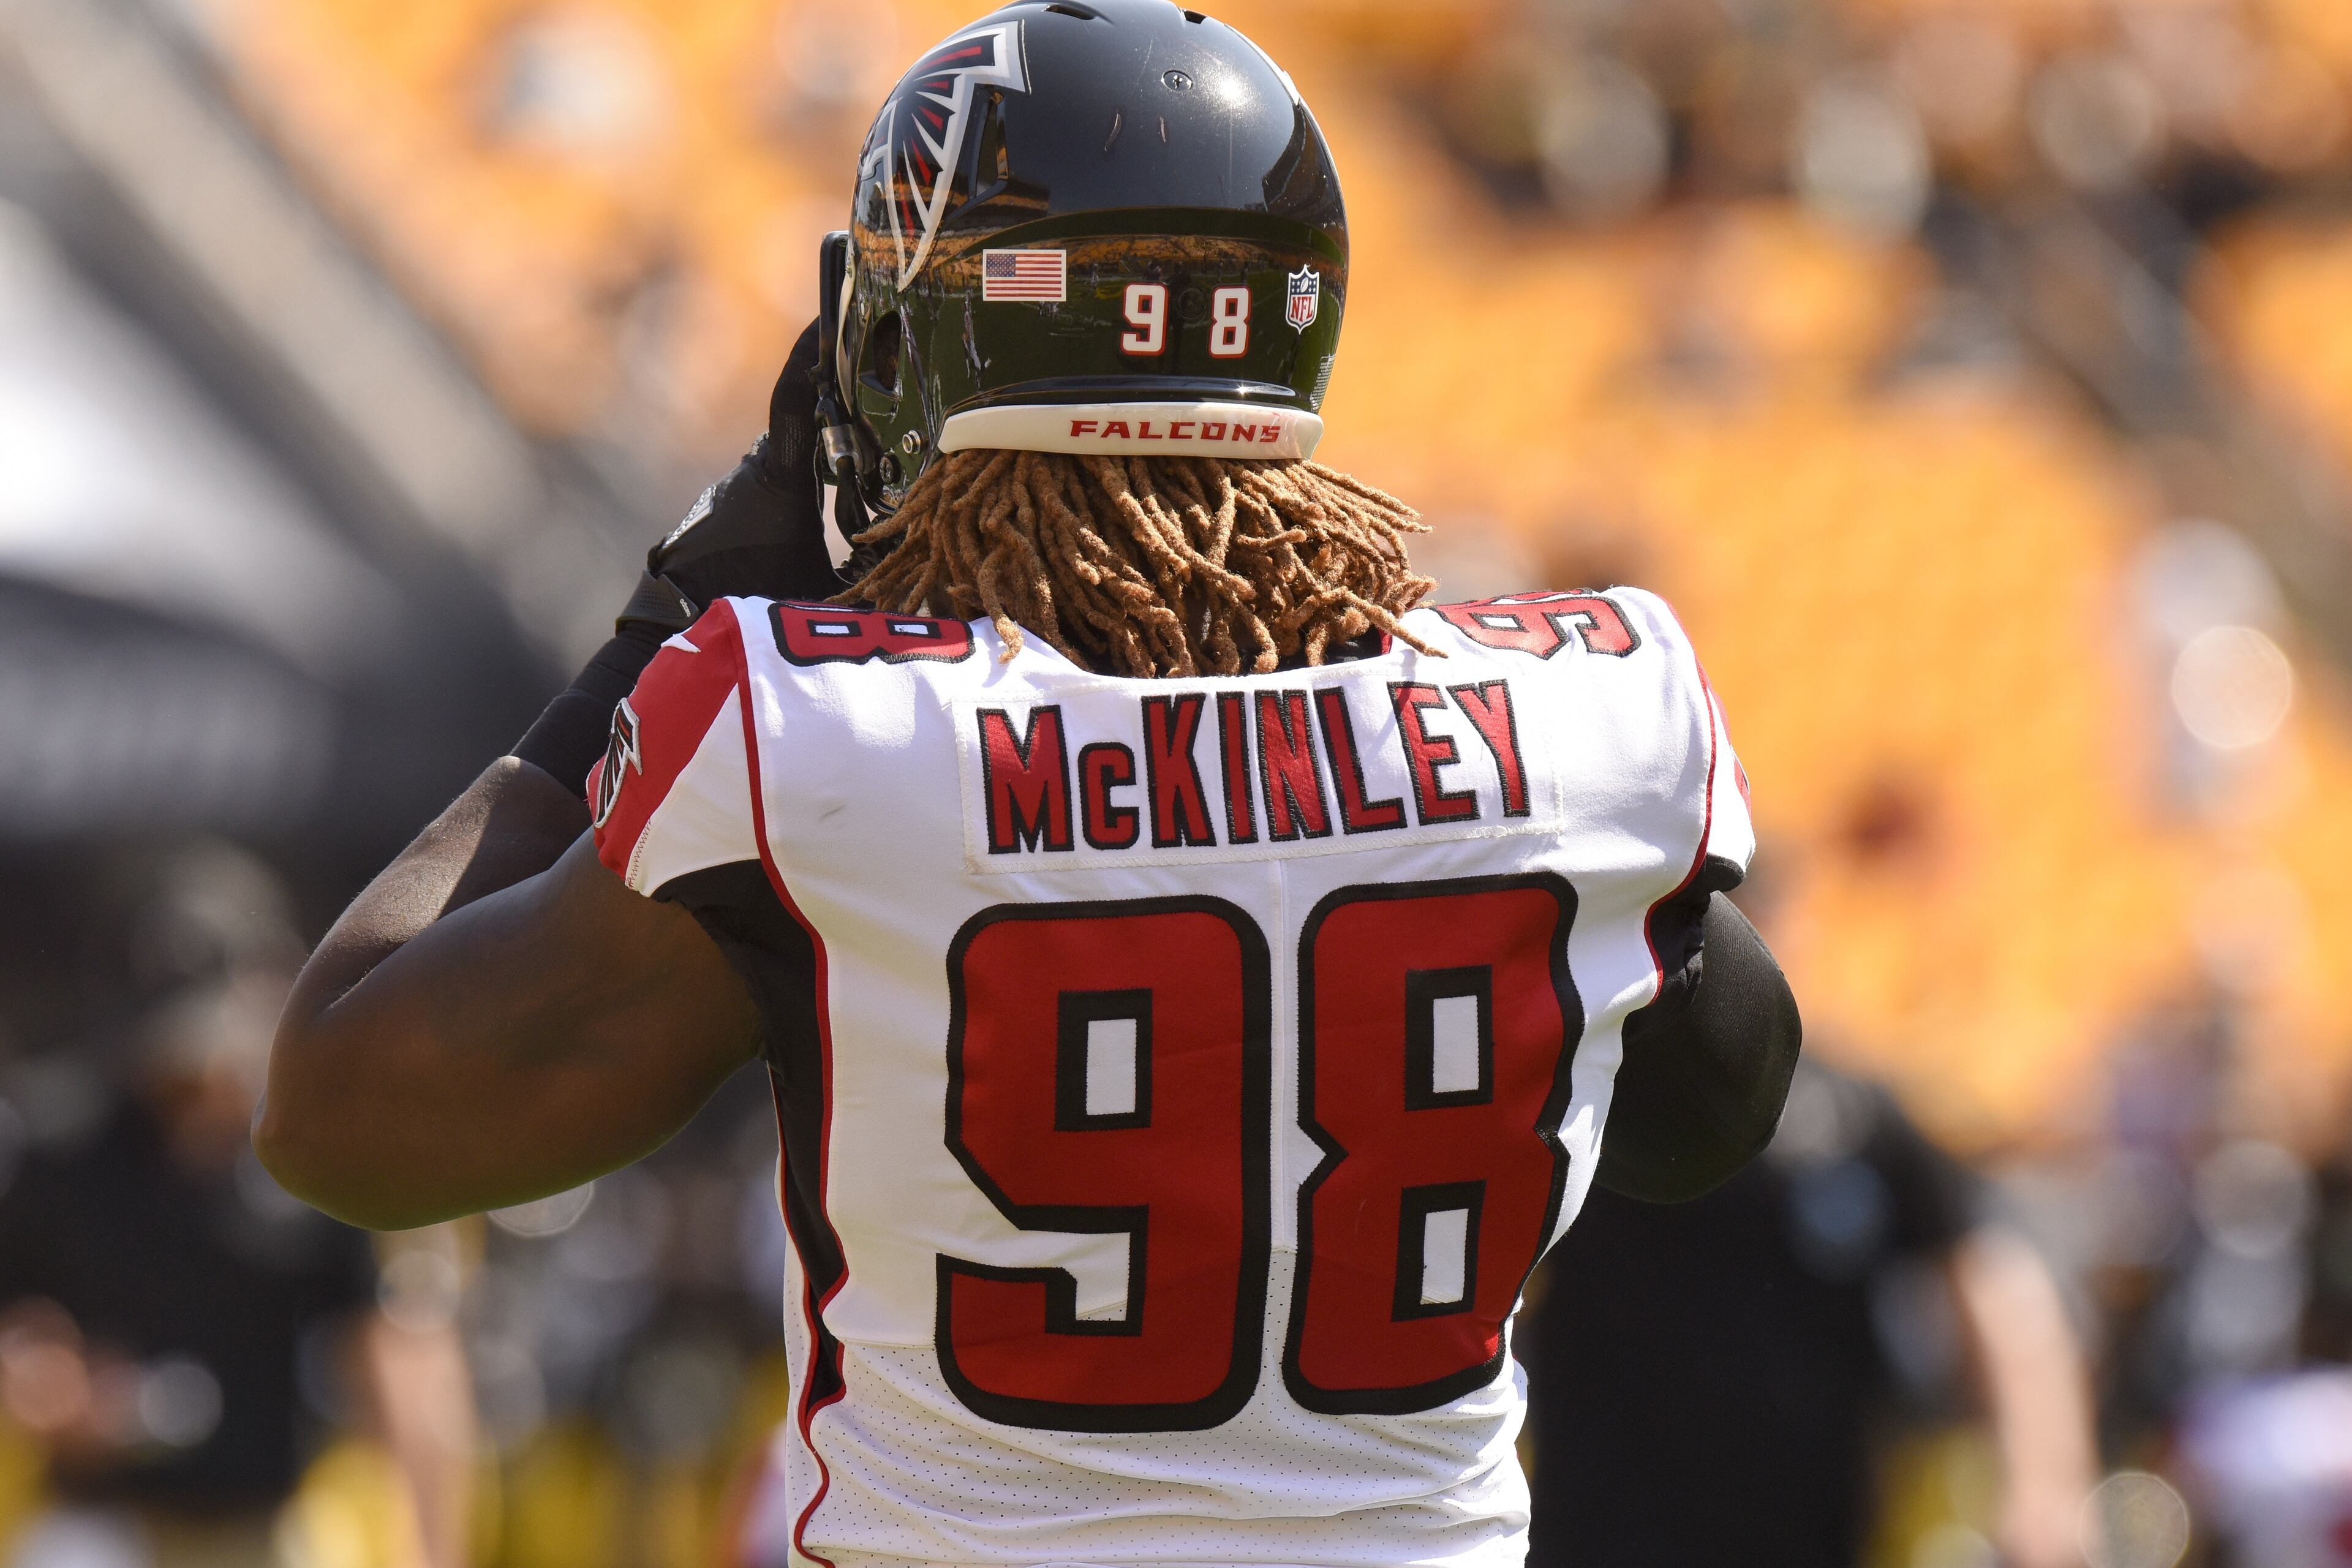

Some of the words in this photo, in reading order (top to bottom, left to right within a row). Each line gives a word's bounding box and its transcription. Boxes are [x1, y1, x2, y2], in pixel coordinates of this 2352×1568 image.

[1120, 282, 1169, 355] 9
[1208, 285, 1252, 358] 8
[1291, 296, 1313, 322] NFL
[1070, 420, 1281, 443] FALCONS
[767, 600, 976, 666] 8
[977, 679, 1530, 854] McKINLEY
[935, 872, 1584, 1433] 98
